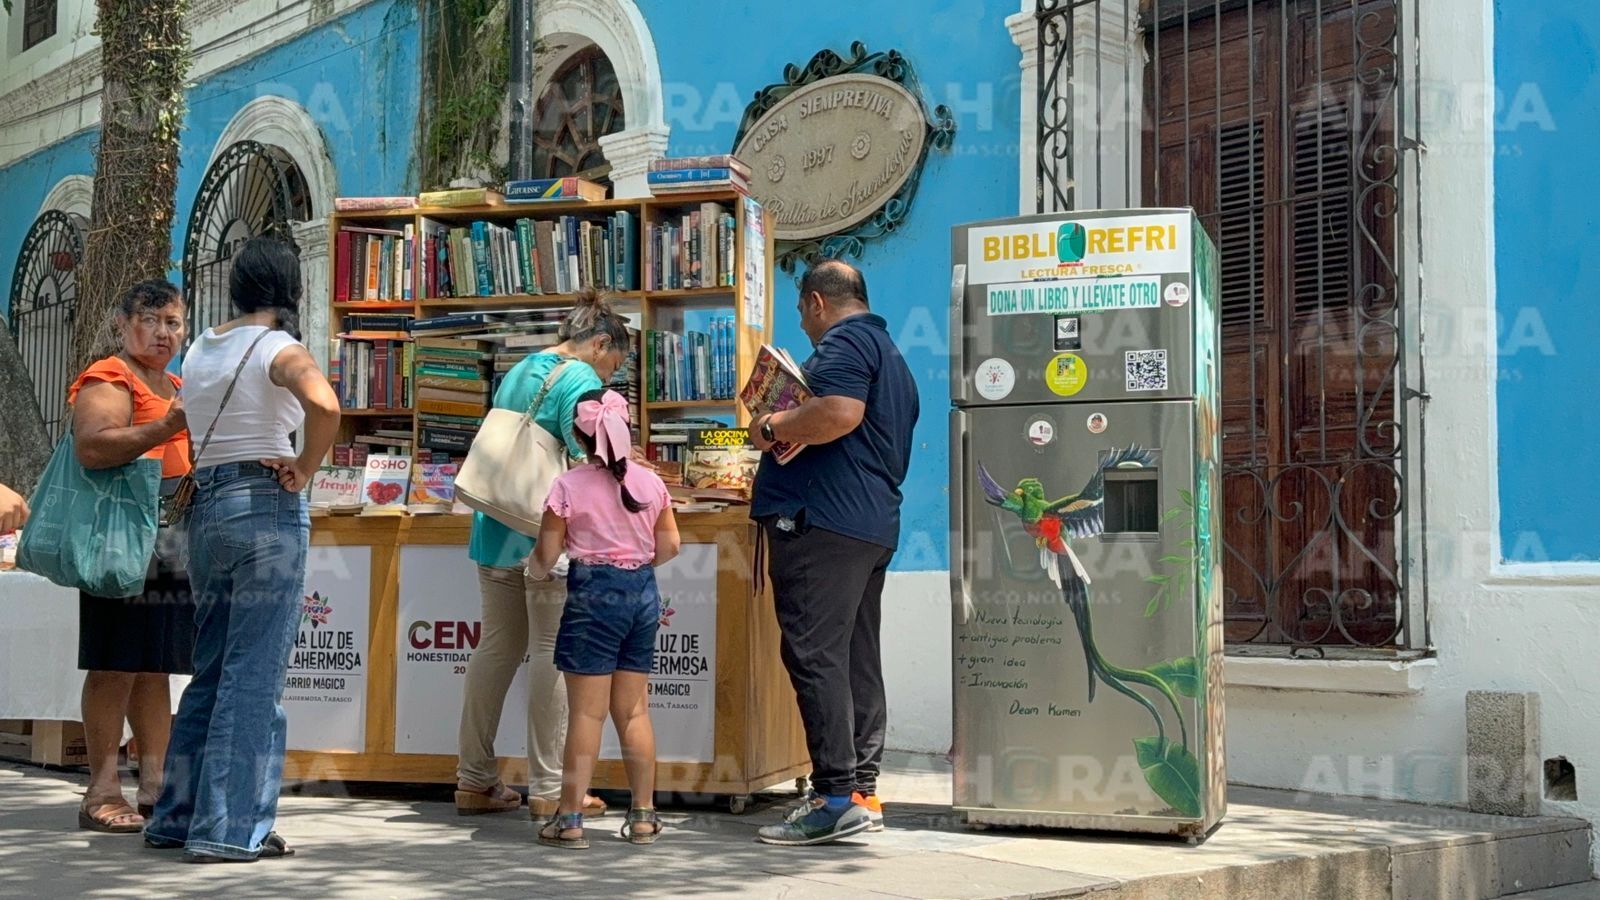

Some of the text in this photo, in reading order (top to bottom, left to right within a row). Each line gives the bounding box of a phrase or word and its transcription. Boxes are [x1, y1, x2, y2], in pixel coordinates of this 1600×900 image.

[753, 115, 788, 152] CASA
[800, 90, 894, 120] SIEMPREVIVA
[802, 145, 835, 169] 1997
[505, 185, 541, 195] Larousse
[1021, 267, 1078, 279] LECTURA
[1082, 264, 1133, 274] FRESCA
[990, 289, 1017, 313] DONA
[1021, 287, 1034, 311] UN
[1038, 286, 1068, 309] LIBRO
[1072, 286, 1079, 307] Y
[1129, 282, 1158, 306] OTRO
[700, 430, 749, 438] LA COCINA
[369, 459, 408, 470] OSHO
[311, 631, 334, 649] LUZ
[337, 631, 353, 649] DE
[408, 620, 481, 649] CEN
[1012, 634, 1062, 647] problema
[682, 634, 699, 653] DE
[287, 651, 361, 670] AHERMOSA
[651, 655, 708, 676] ERMOSA
[968, 656, 994, 669] gran
[1003, 656, 1026, 667] idea
[454, 666, 466, 674] 20
[286, 677, 311, 689] ARRIO
[655, 682, 690, 697] MÁGICO
